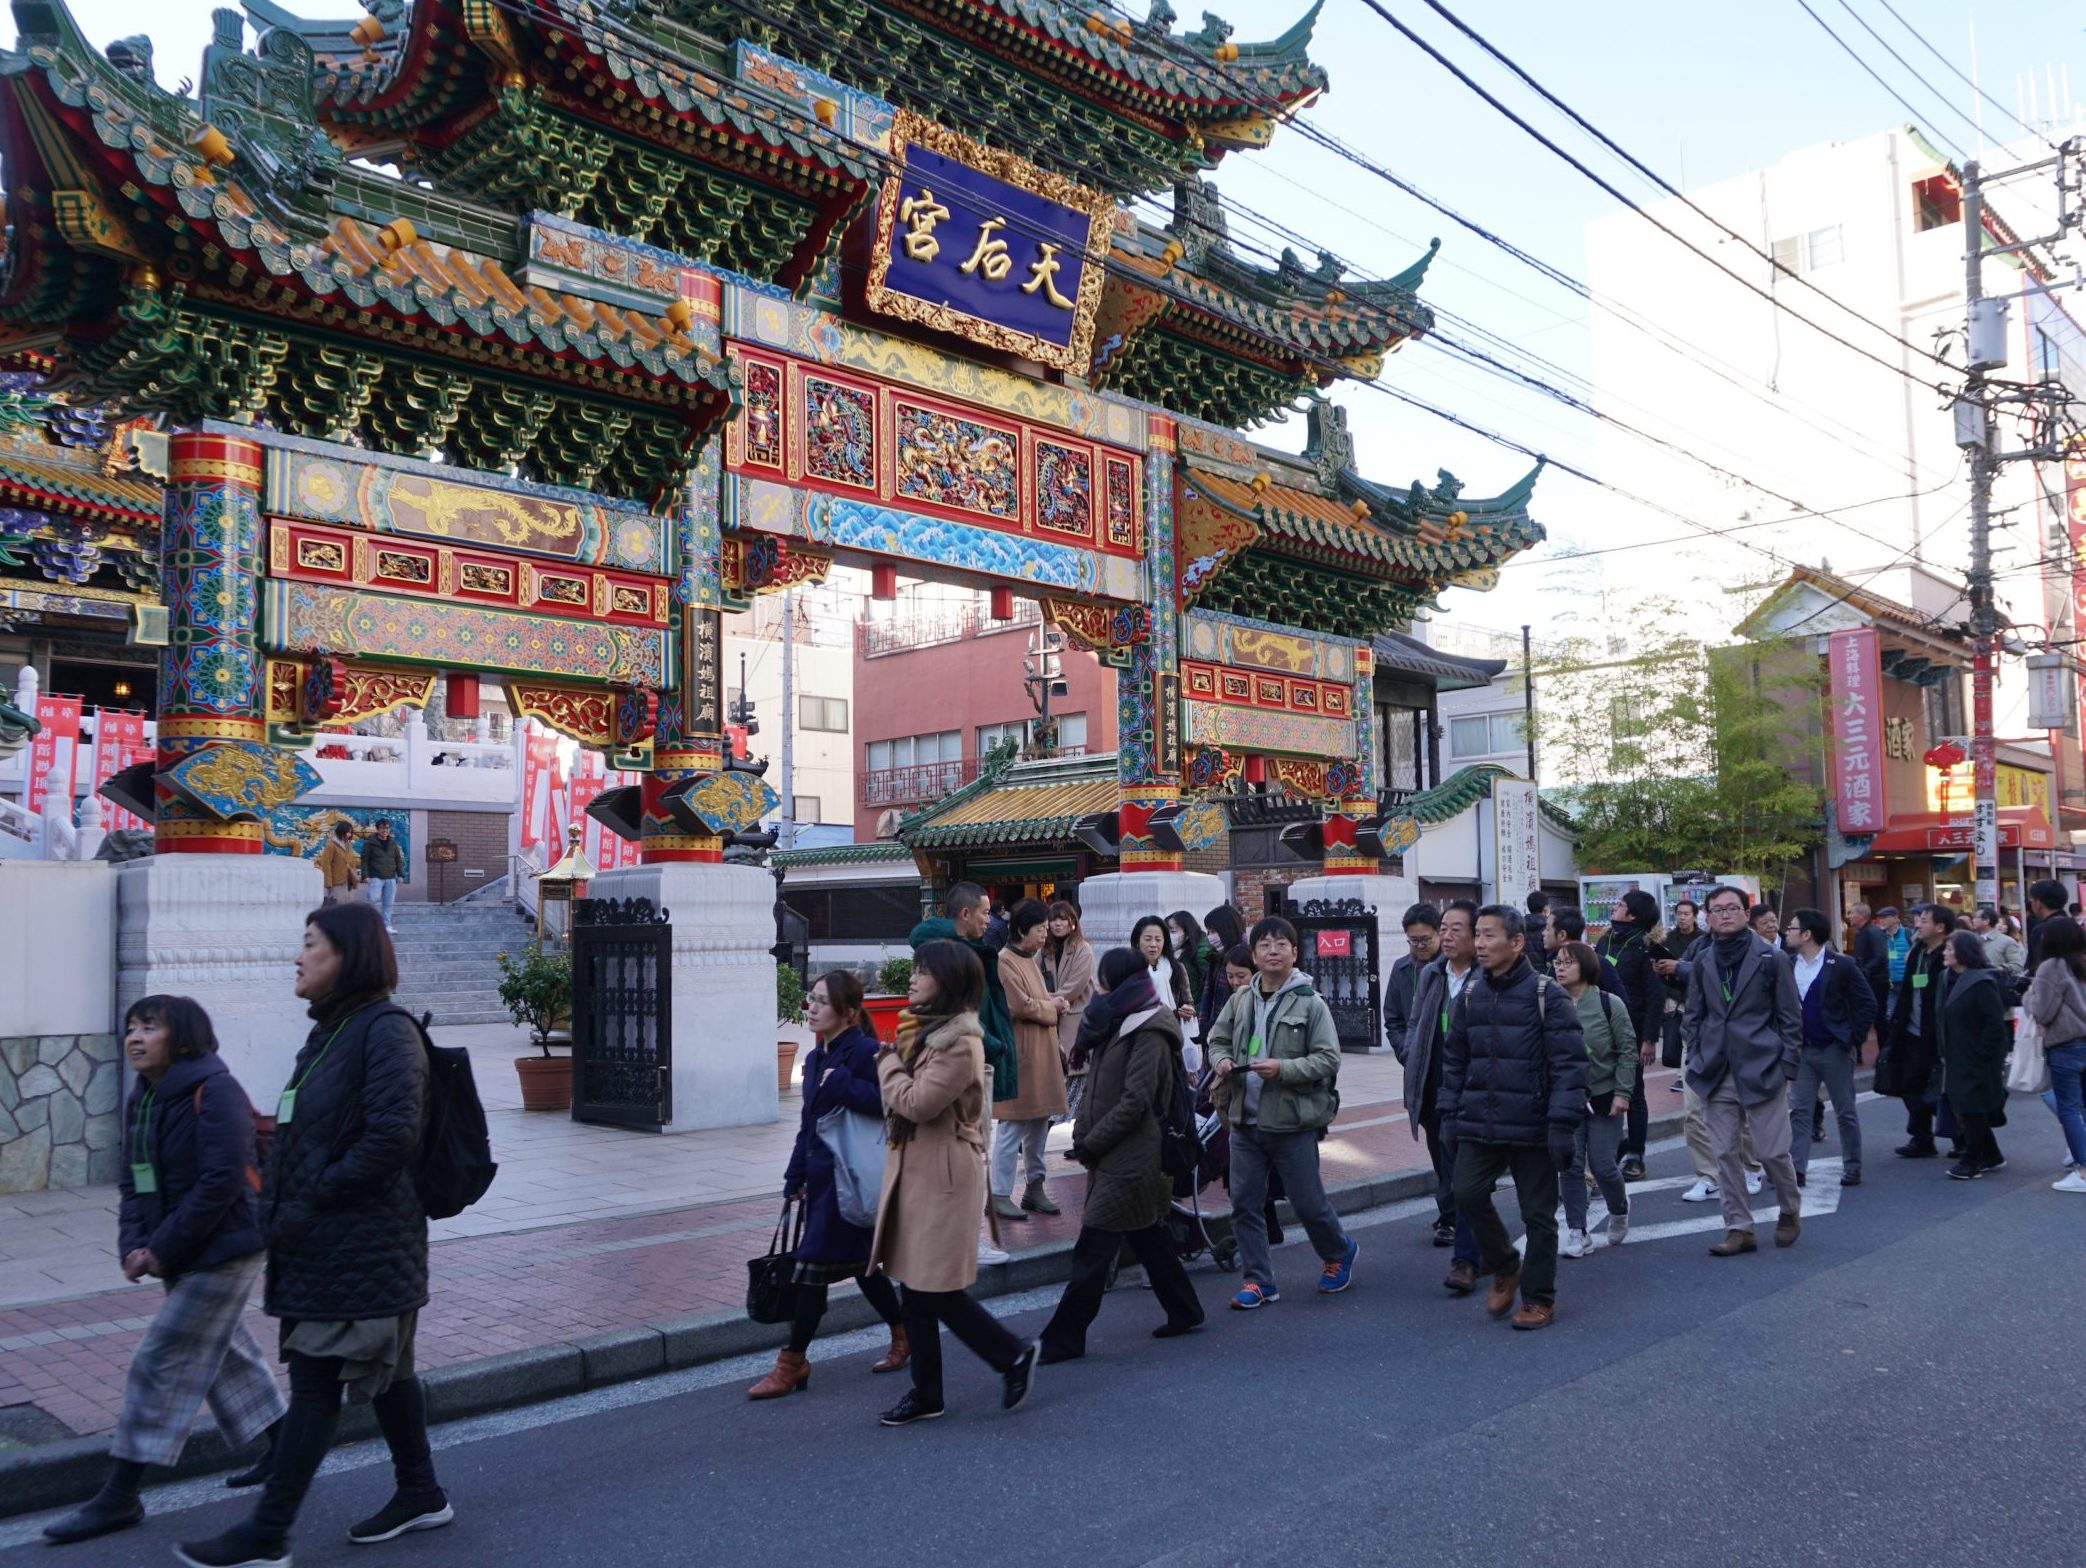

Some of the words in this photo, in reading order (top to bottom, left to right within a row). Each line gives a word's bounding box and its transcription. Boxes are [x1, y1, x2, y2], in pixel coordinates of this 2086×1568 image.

[900, 185, 1076, 311] 天后宮
[1844, 636, 1861, 688] 上海料理
[1843, 692, 1873, 827] 大三元酒家
[1885, 716, 1915, 763] 酒家
[1320, 937, 1345, 948] 入口
